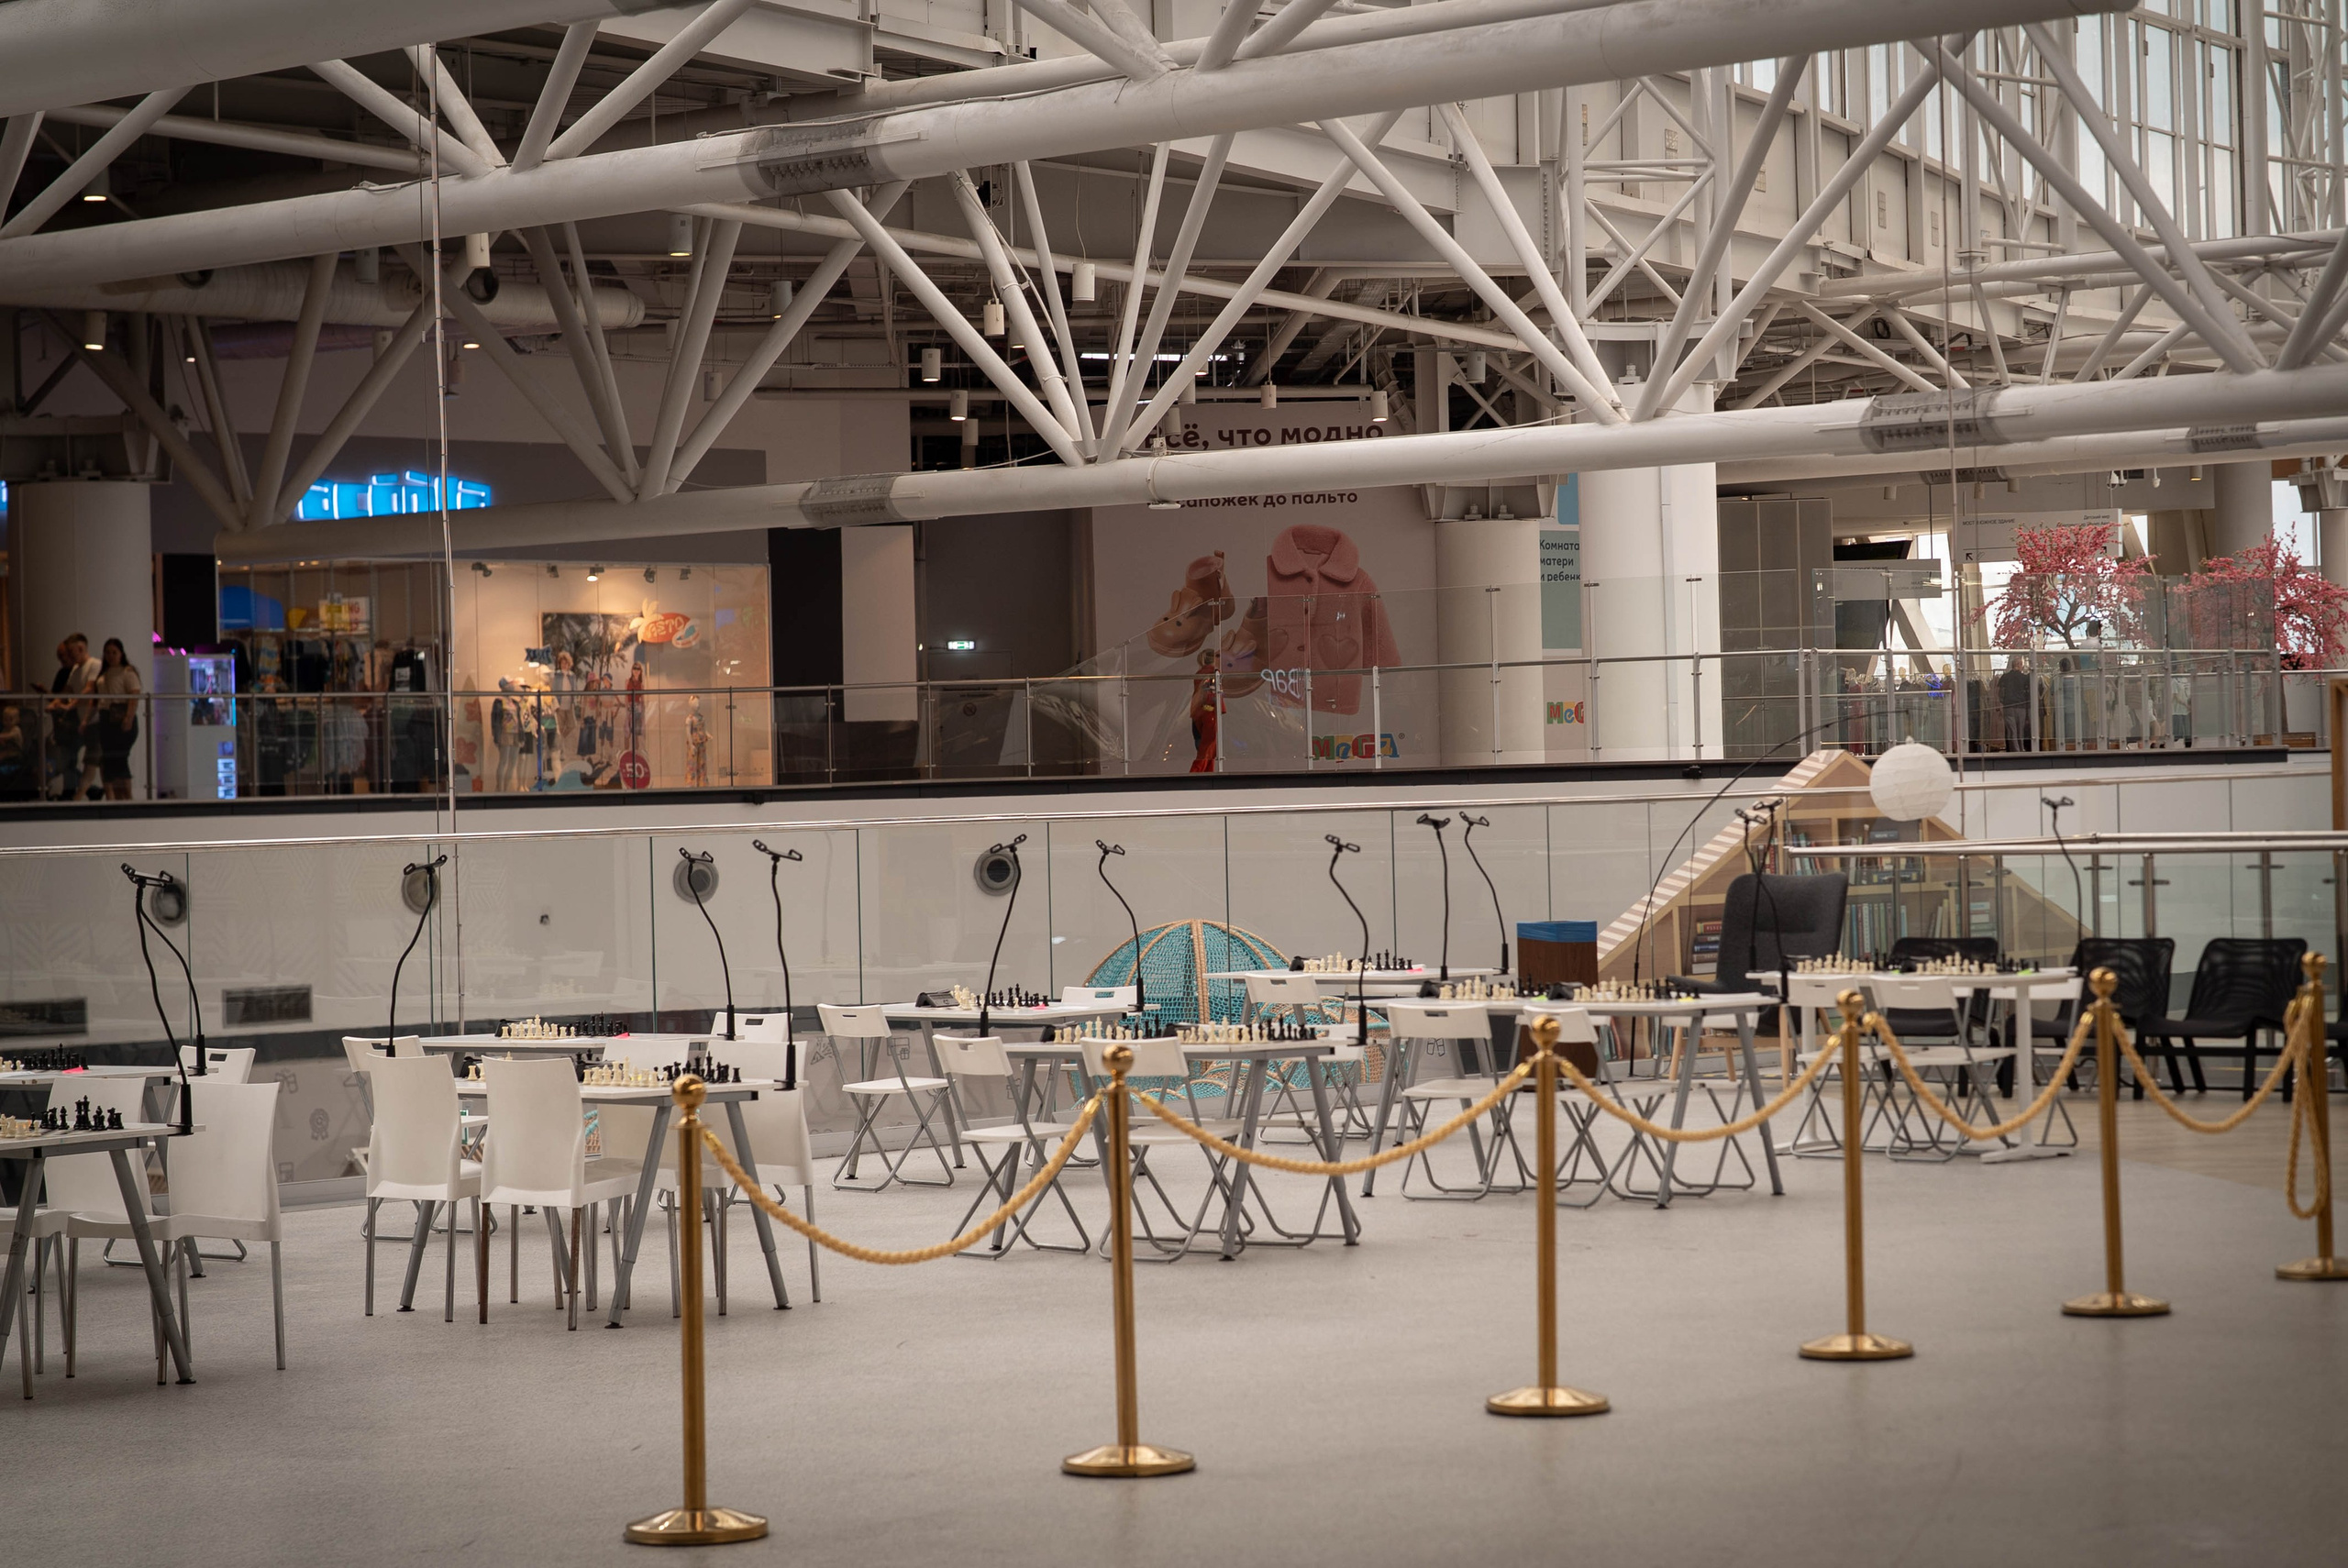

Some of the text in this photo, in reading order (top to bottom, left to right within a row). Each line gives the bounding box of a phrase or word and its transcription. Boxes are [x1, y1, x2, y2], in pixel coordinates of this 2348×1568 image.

[1218, 425, 1271, 447] что
[1281, 425, 1384, 444] модно
[1263, 494, 1286, 508] до
[1292, 492, 1358, 504] пальто
[1540, 539, 1579, 550] Комната
[1540, 558, 1574, 569] матери
